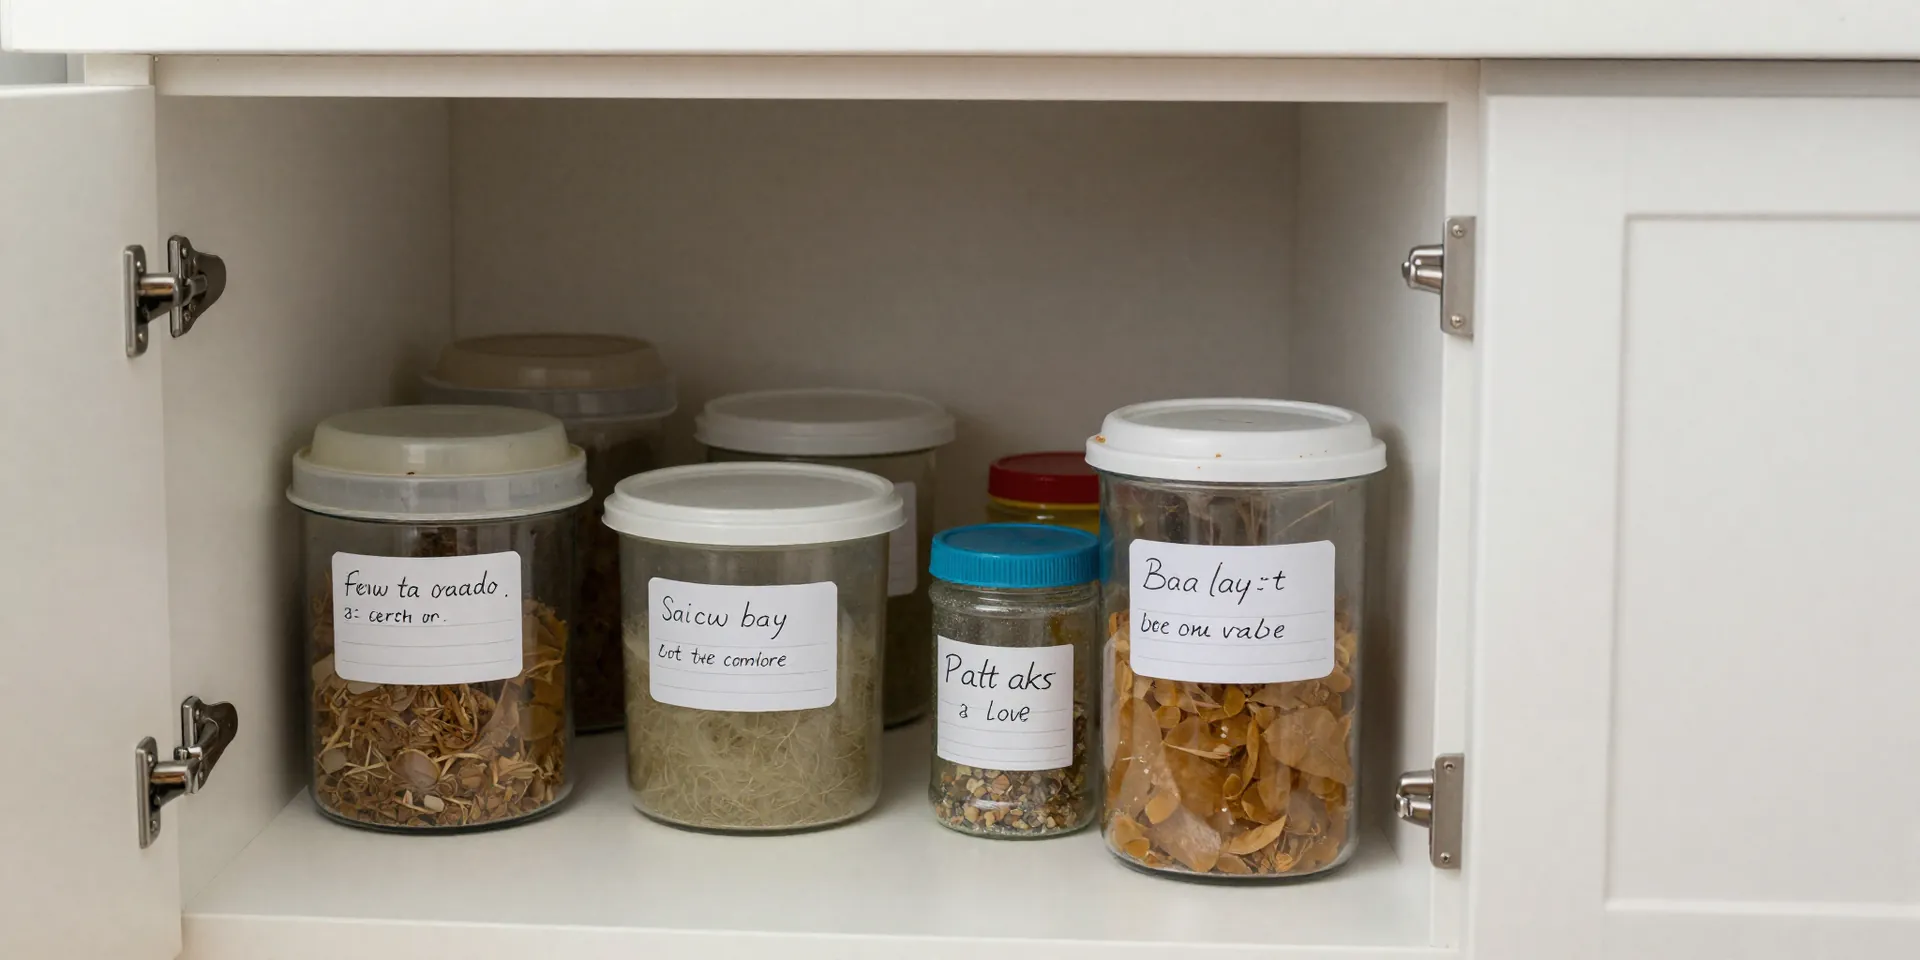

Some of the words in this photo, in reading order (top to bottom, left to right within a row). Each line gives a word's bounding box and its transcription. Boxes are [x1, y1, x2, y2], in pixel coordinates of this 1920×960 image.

[397, 575, 420, 598] ta
[1142, 557, 1199, 592] Baa
[661, 595, 729, 628] Saicw
[740, 600, 788, 641] bay
[945, 653, 1000, 689] Patt
[1007, 660, 1057, 690] aks
